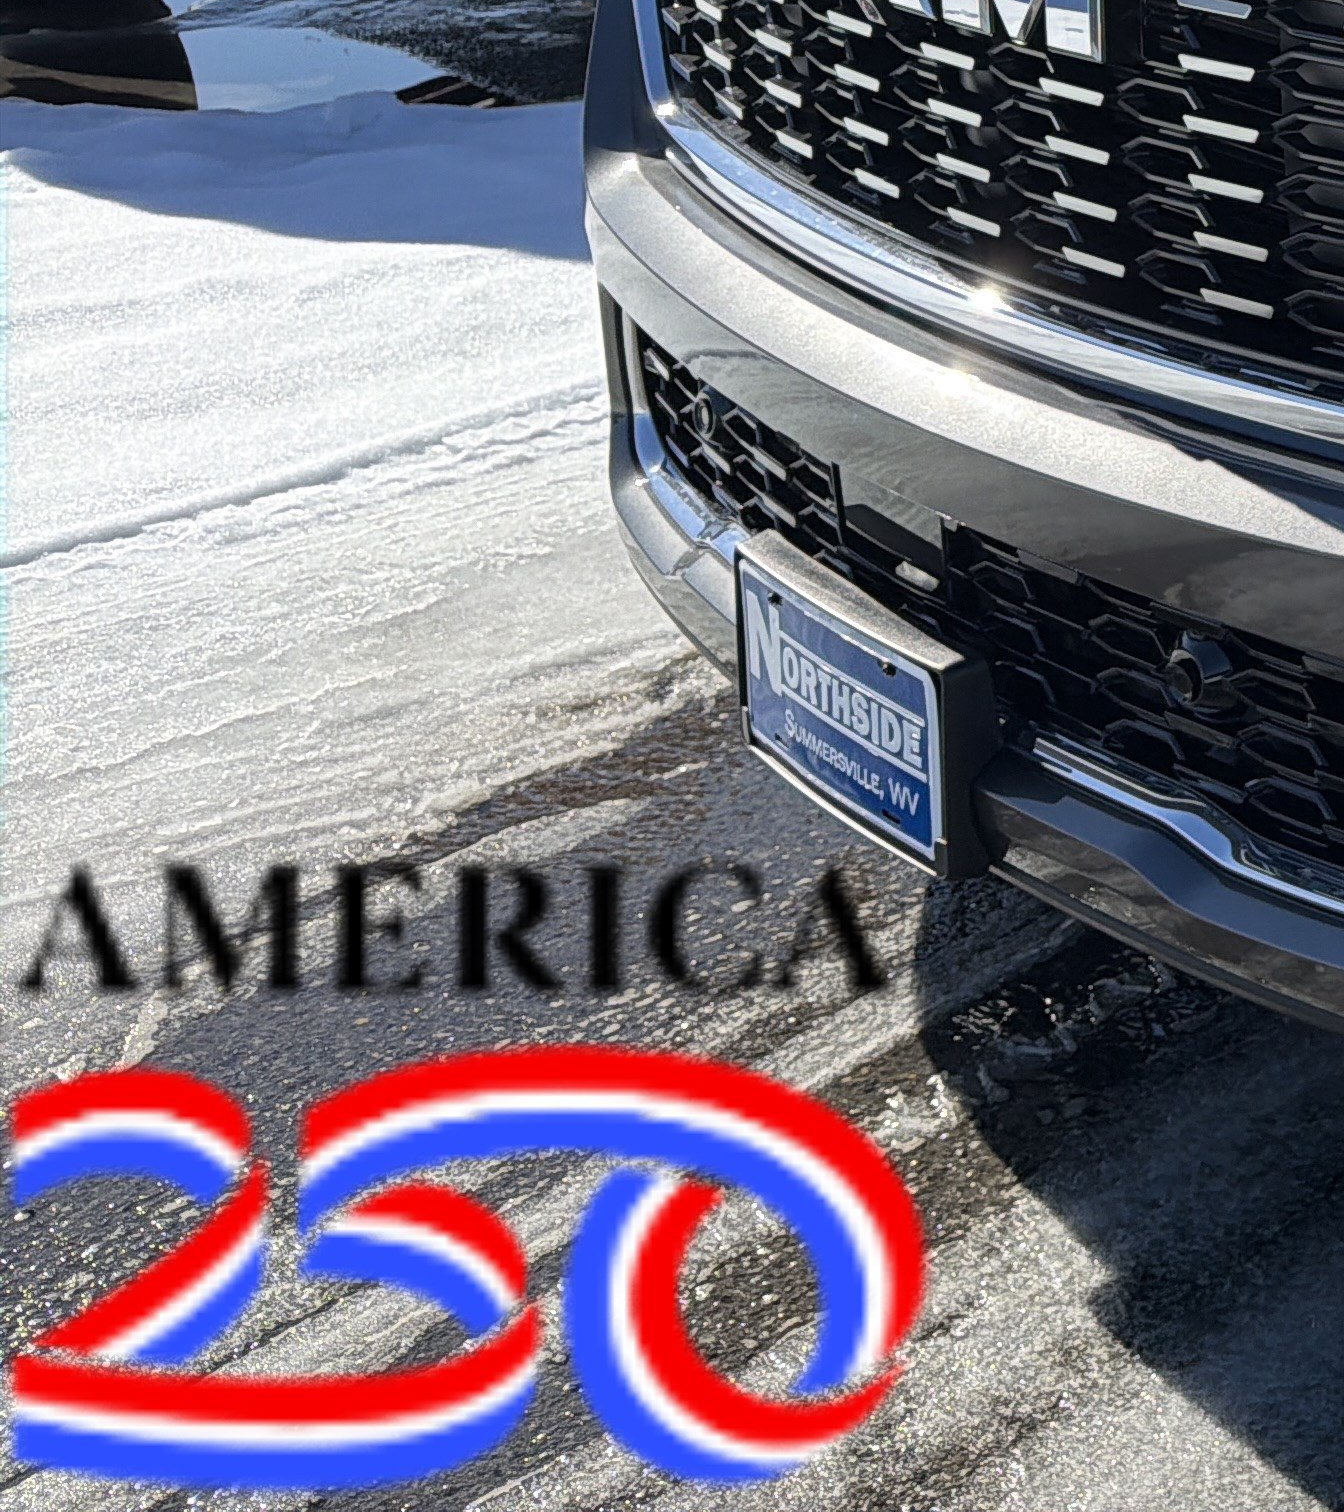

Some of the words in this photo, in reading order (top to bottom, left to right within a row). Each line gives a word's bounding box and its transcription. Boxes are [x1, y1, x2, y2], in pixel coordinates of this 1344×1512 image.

[746, 589, 924, 770] NORTHSIDE
[784, 709, 885, 801] SUMMERSVILLE,
[888, 777, 920, 815] WV
